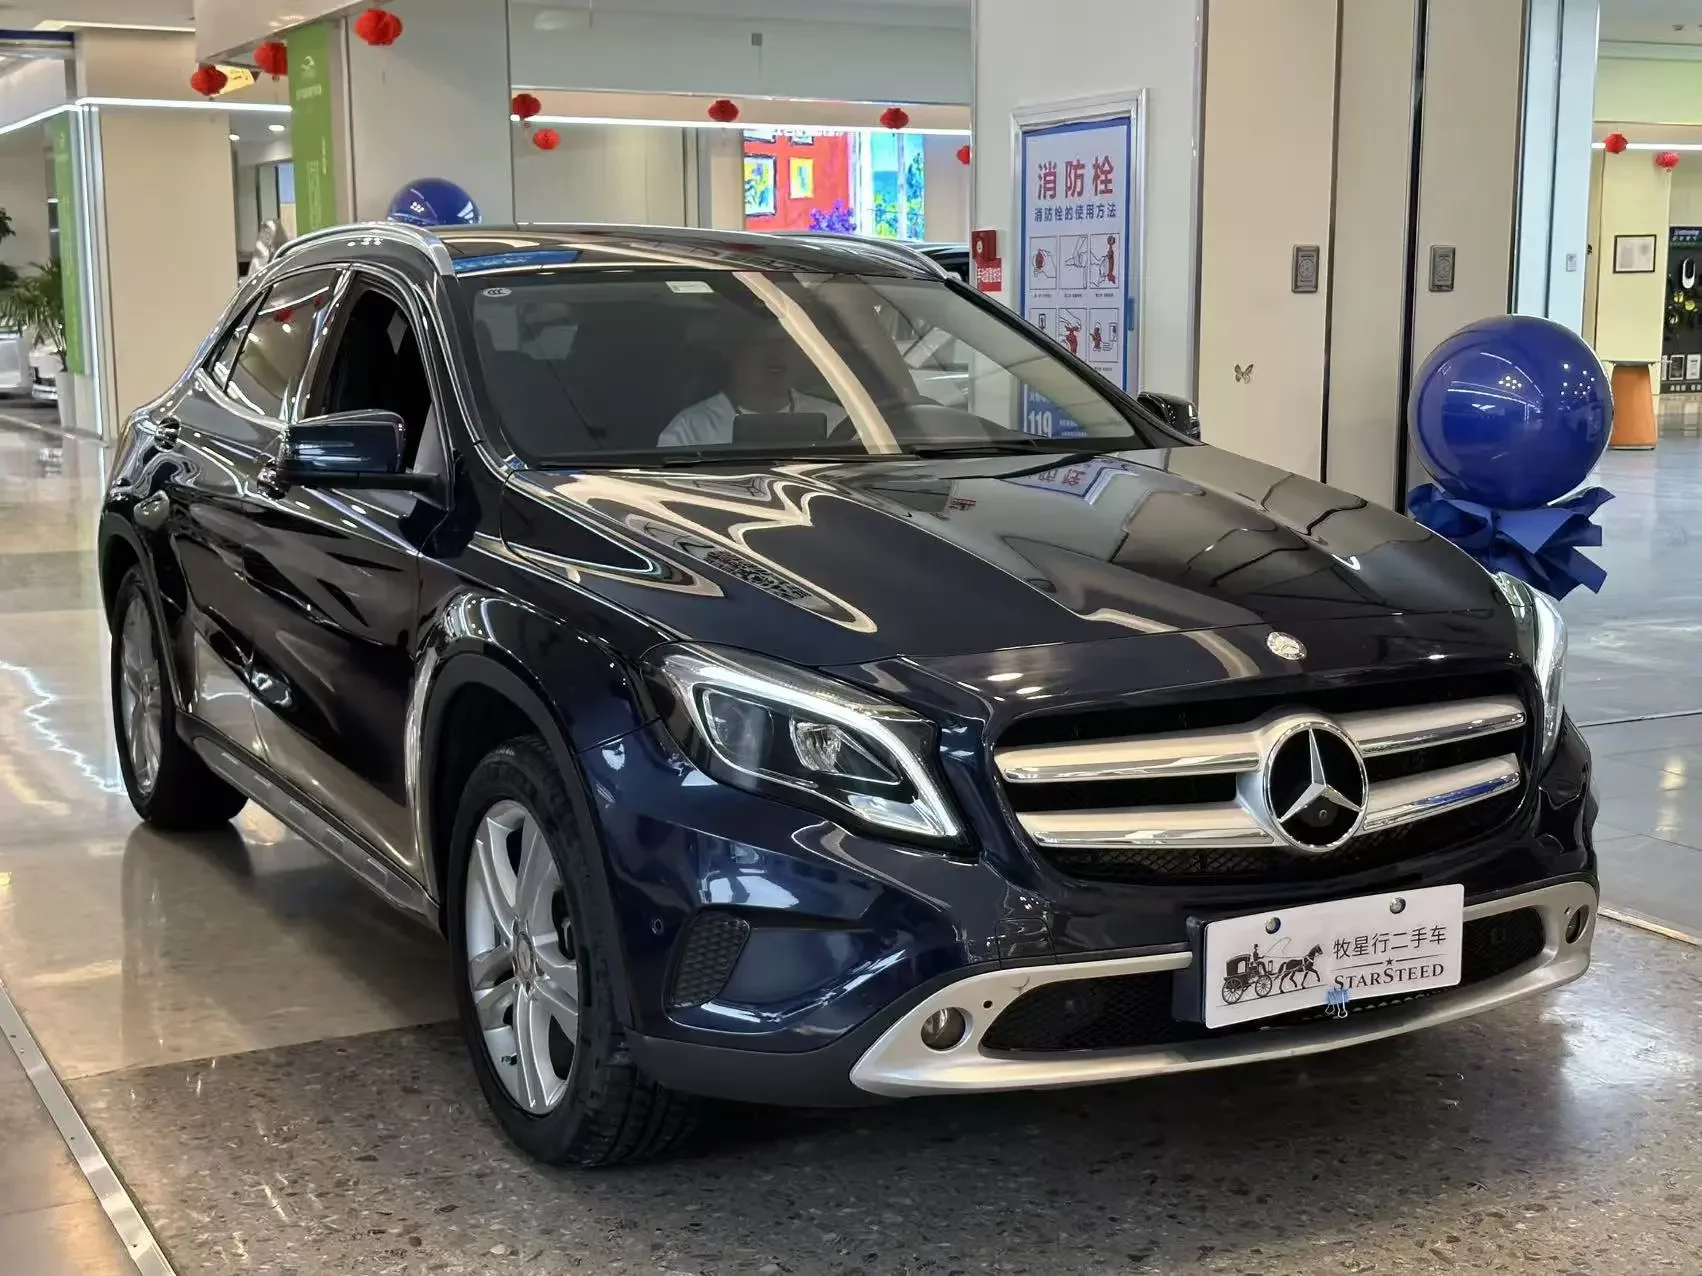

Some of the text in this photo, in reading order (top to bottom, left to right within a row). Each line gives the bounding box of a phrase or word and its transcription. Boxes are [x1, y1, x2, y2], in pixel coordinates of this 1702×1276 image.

[1037, 154, 1114, 200] 消防栓
[1034, 203, 1117, 223] 消防栓的使用方法
[1028, 410, 1053, 437] 119
[1333, 925, 1447, 960] 牧星行二手车
[1334, 963, 1445, 991] STARSTEED
